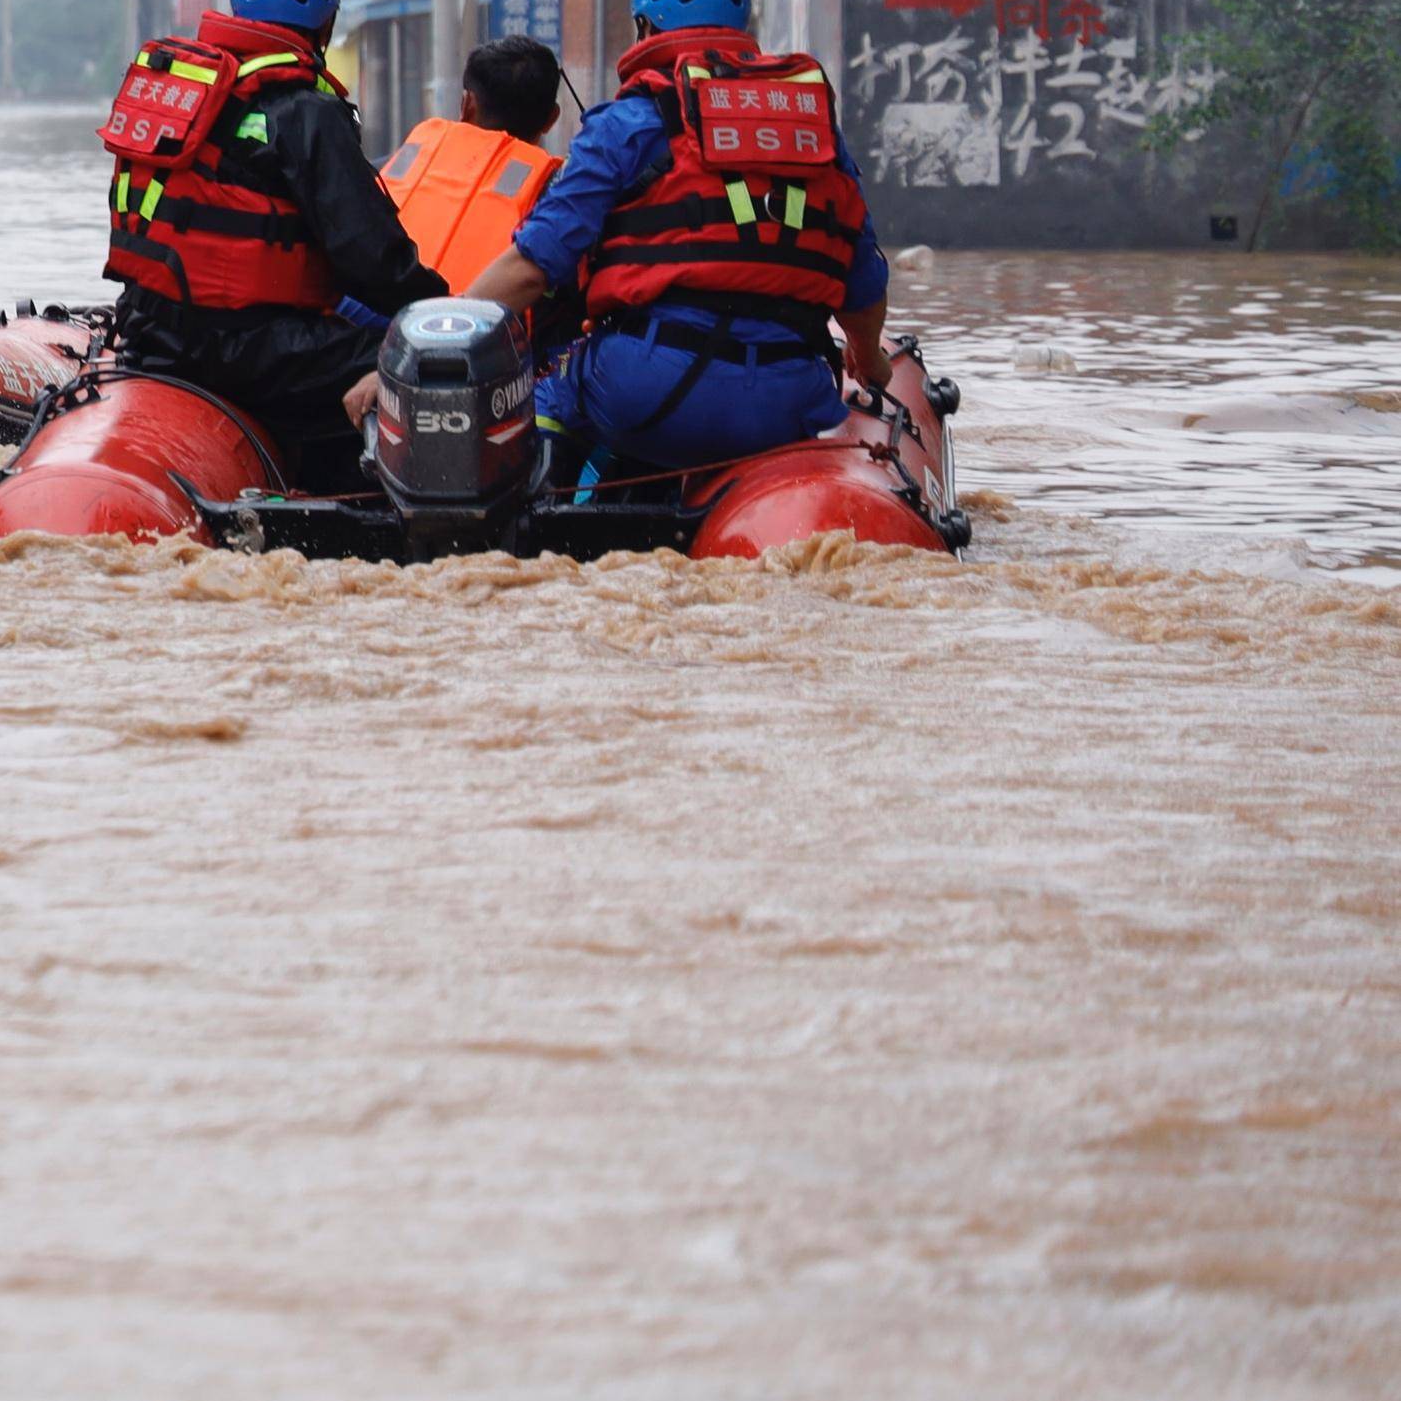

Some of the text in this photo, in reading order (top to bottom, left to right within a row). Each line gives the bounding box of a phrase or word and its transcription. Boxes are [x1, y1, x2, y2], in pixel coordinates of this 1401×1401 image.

[126, 76, 200, 112] 蓝天救援
[708, 87, 819, 115] 蓝天救援
[712, 126, 819, 154] BSR
[415, 410, 472, 434] 30
